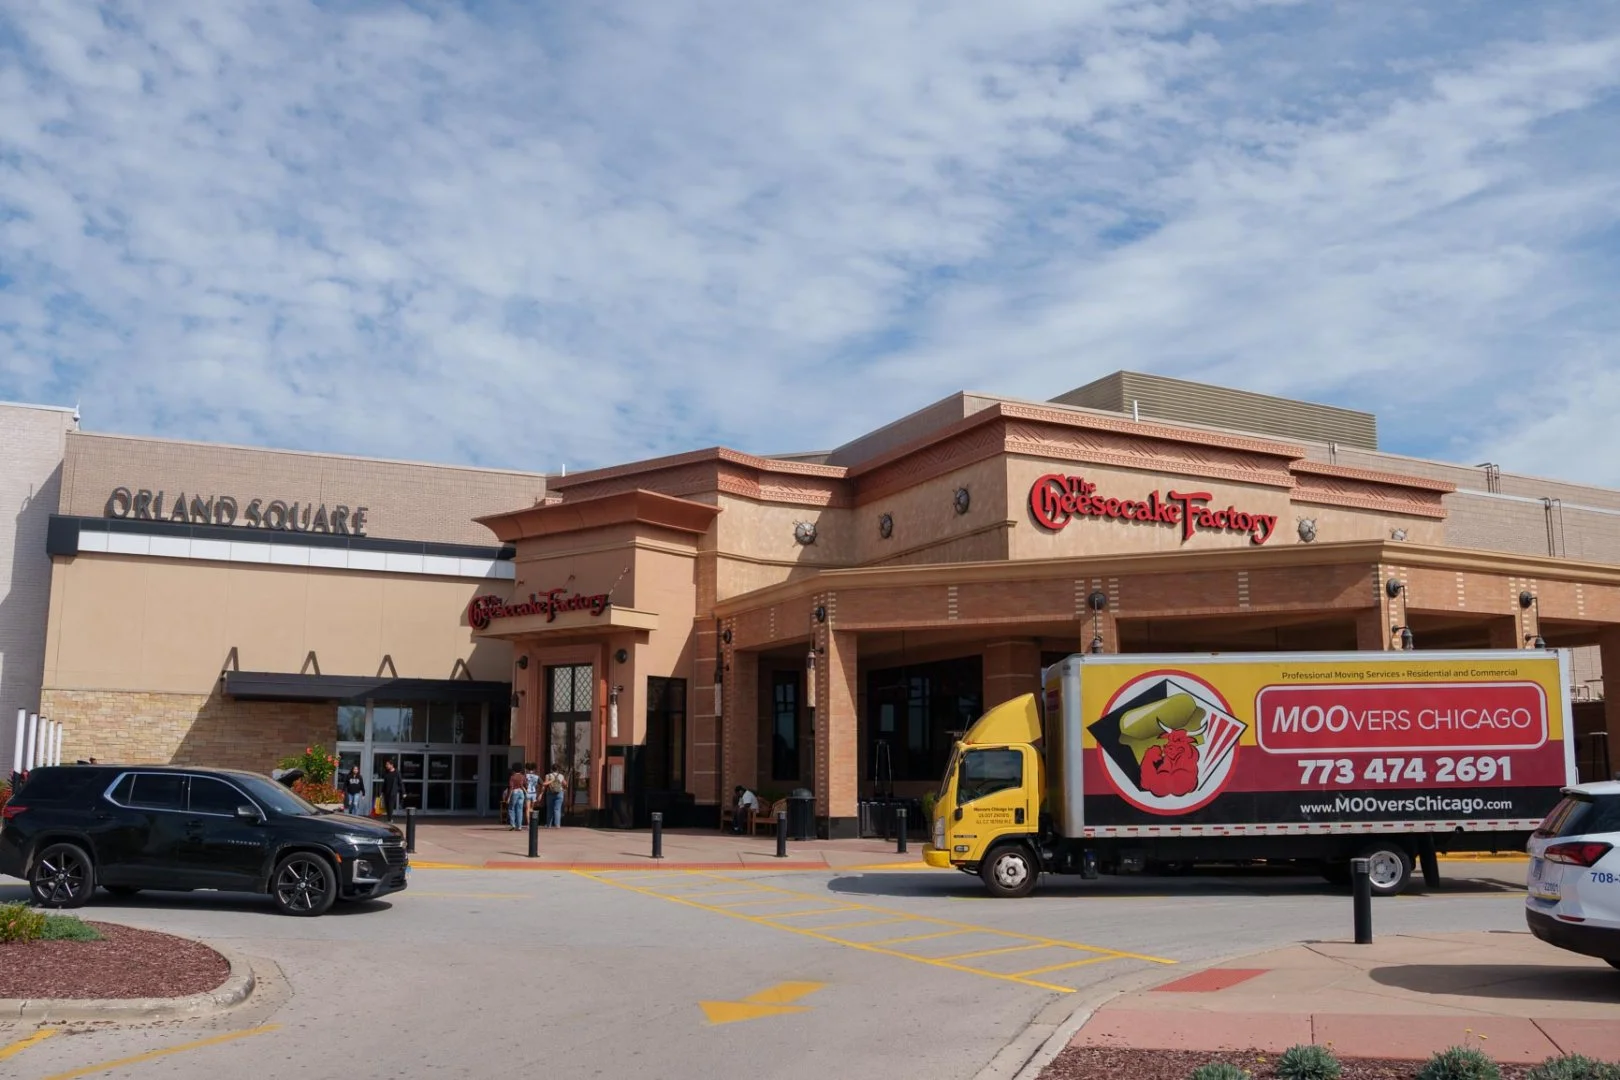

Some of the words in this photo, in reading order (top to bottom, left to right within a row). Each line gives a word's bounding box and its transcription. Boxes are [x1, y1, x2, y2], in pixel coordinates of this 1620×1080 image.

[1068, 475, 1097, 496] The
[107, 486, 239, 528] ORLAND
[246, 497, 369, 537] SQUARE
[1029, 473, 1182, 530] Cheesecake
[1168, 490, 1278, 544] Factory
[468, 593, 547, 631] Cheesecake
[539, 588, 610, 624] Factory
[1282, 671, 1333, 680] Professional
[1335, 670, 1365, 680] Moving
[1366, 670, 1400, 679] Services
[1407, 669, 1451, 678] Residential
[1453, 669, 1469, 677] and
[1470, 668, 1518, 677] Commercial
[1417, 708, 1532, 730] CHICAGO
[1298, 758, 1355, 785] 773
[1363, 757, 1426, 783] 474
[1435, 756, 1513, 782] 2691
[1300, 796, 1513, 815] www.MOOversChicago.com
[1590, 872, 1620, 884] 708-
